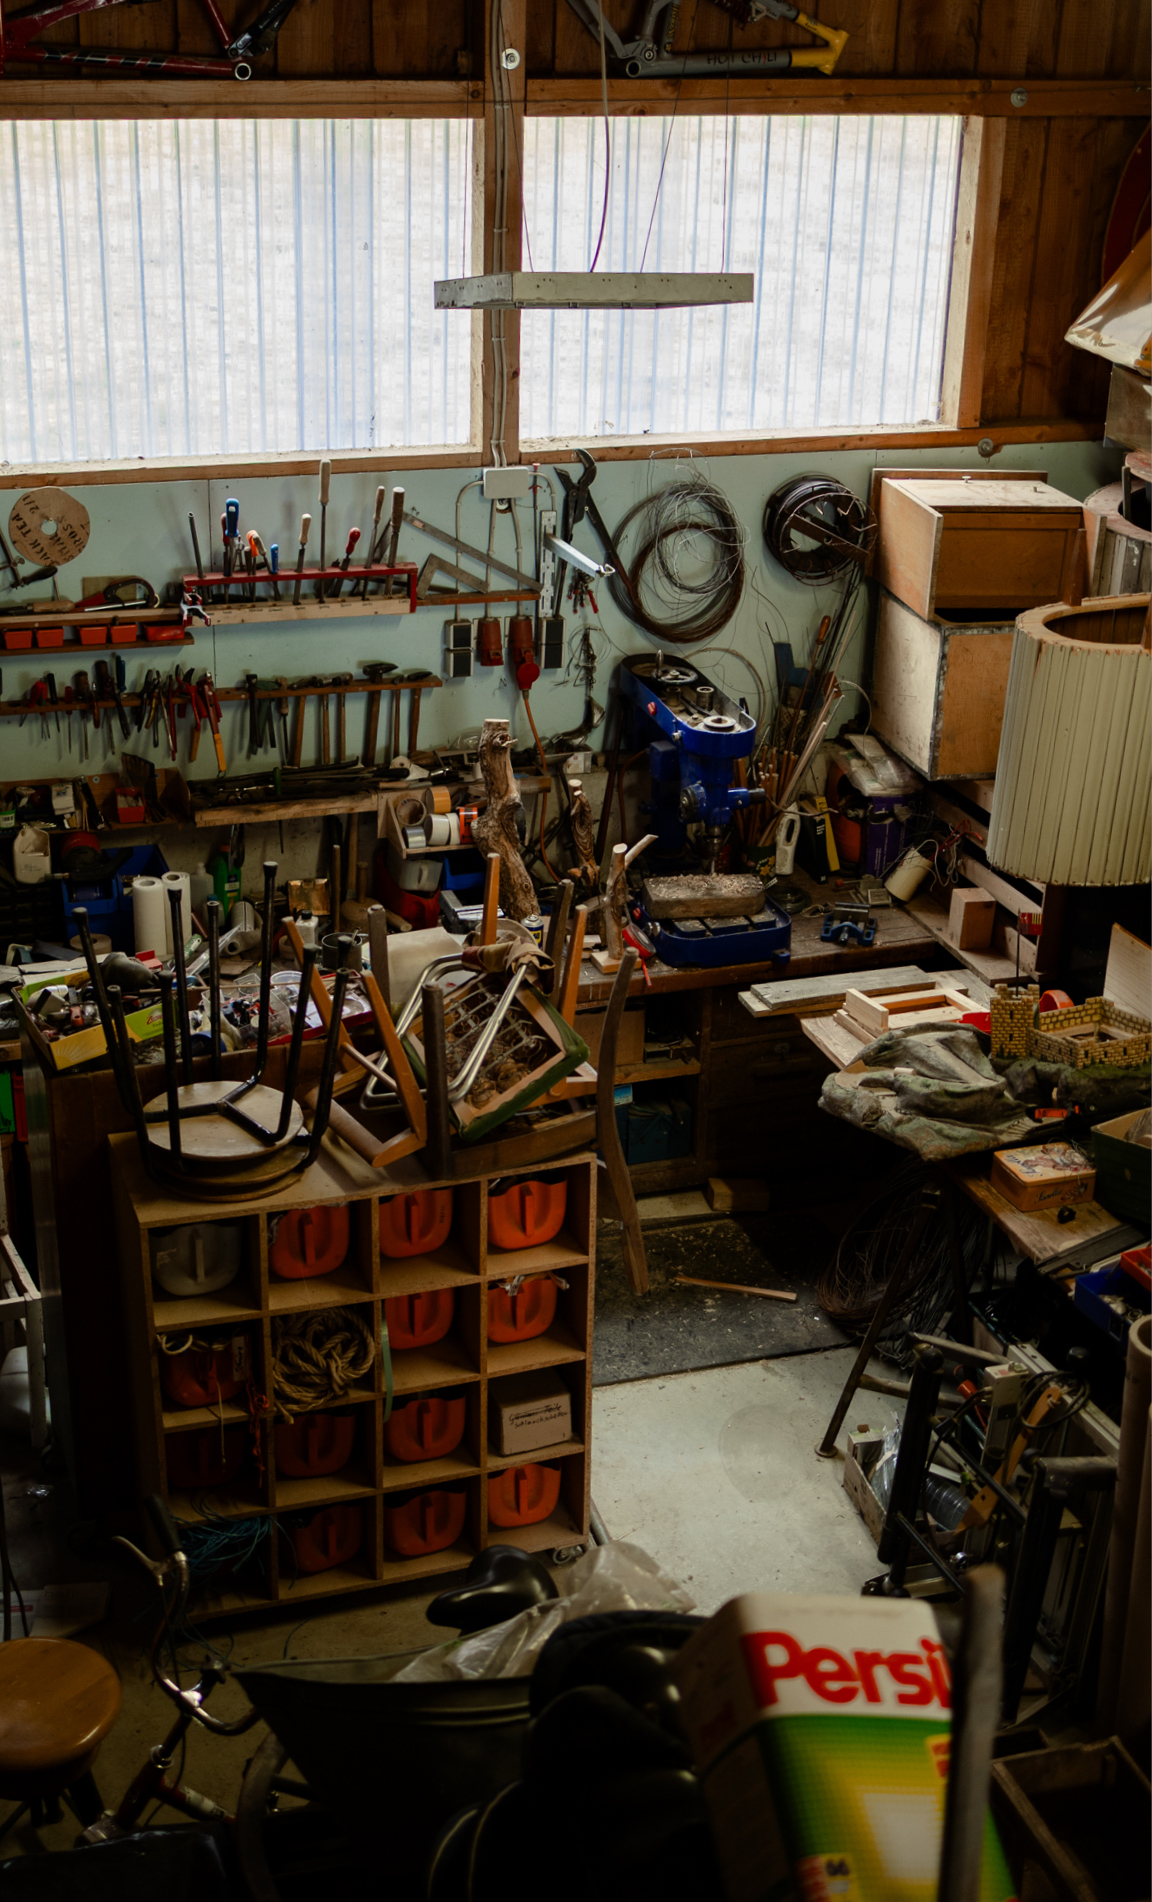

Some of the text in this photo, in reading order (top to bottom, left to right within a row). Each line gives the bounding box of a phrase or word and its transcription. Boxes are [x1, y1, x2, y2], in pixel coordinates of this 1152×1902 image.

[706, 51, 778, 65] HOT CHILI
[12, 513, 32, 538] TEA
